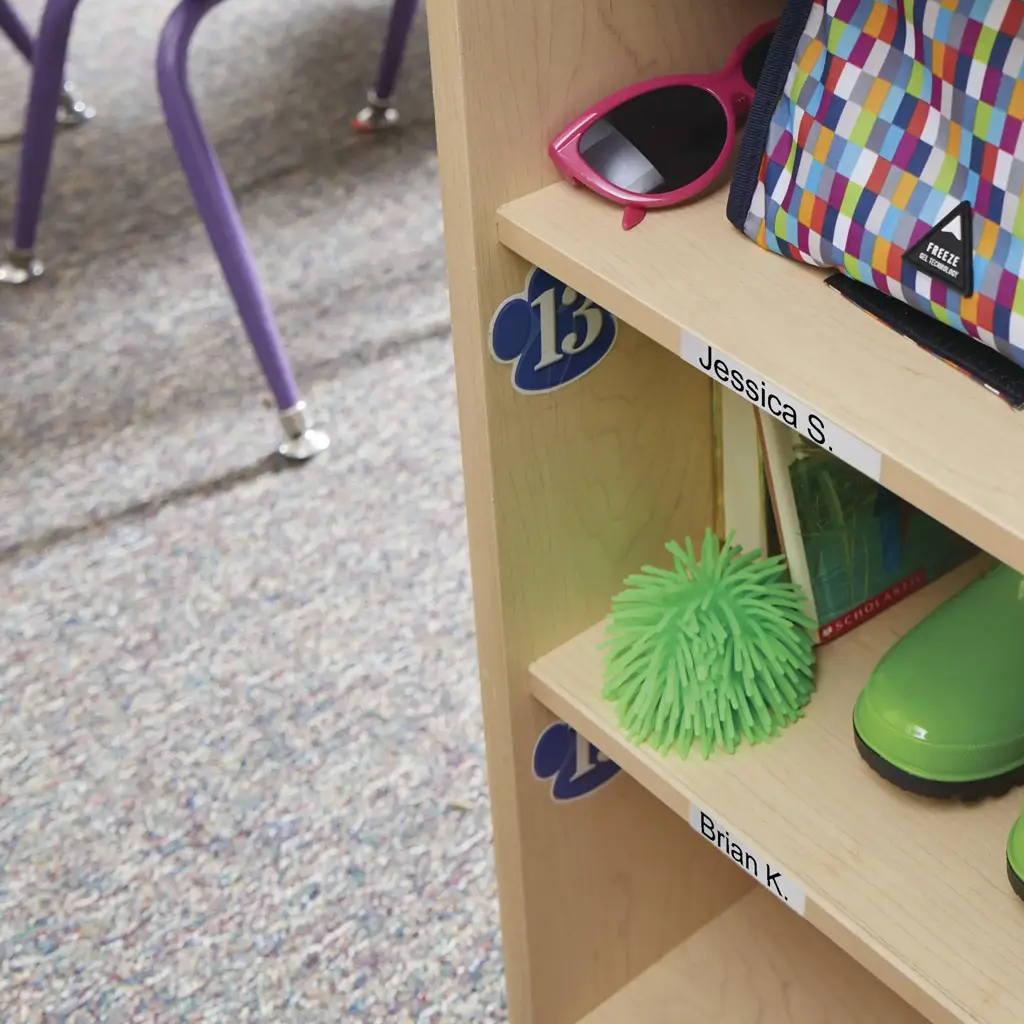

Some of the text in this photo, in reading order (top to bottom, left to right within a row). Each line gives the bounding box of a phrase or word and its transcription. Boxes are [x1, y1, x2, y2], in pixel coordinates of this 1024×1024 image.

[926, 241, 961, 268] FREEZE
[530, 286, 605, 372] 13
[698, 344, 834, 452] Jessica S.
[699, 810, 789, 901] Brian K.
